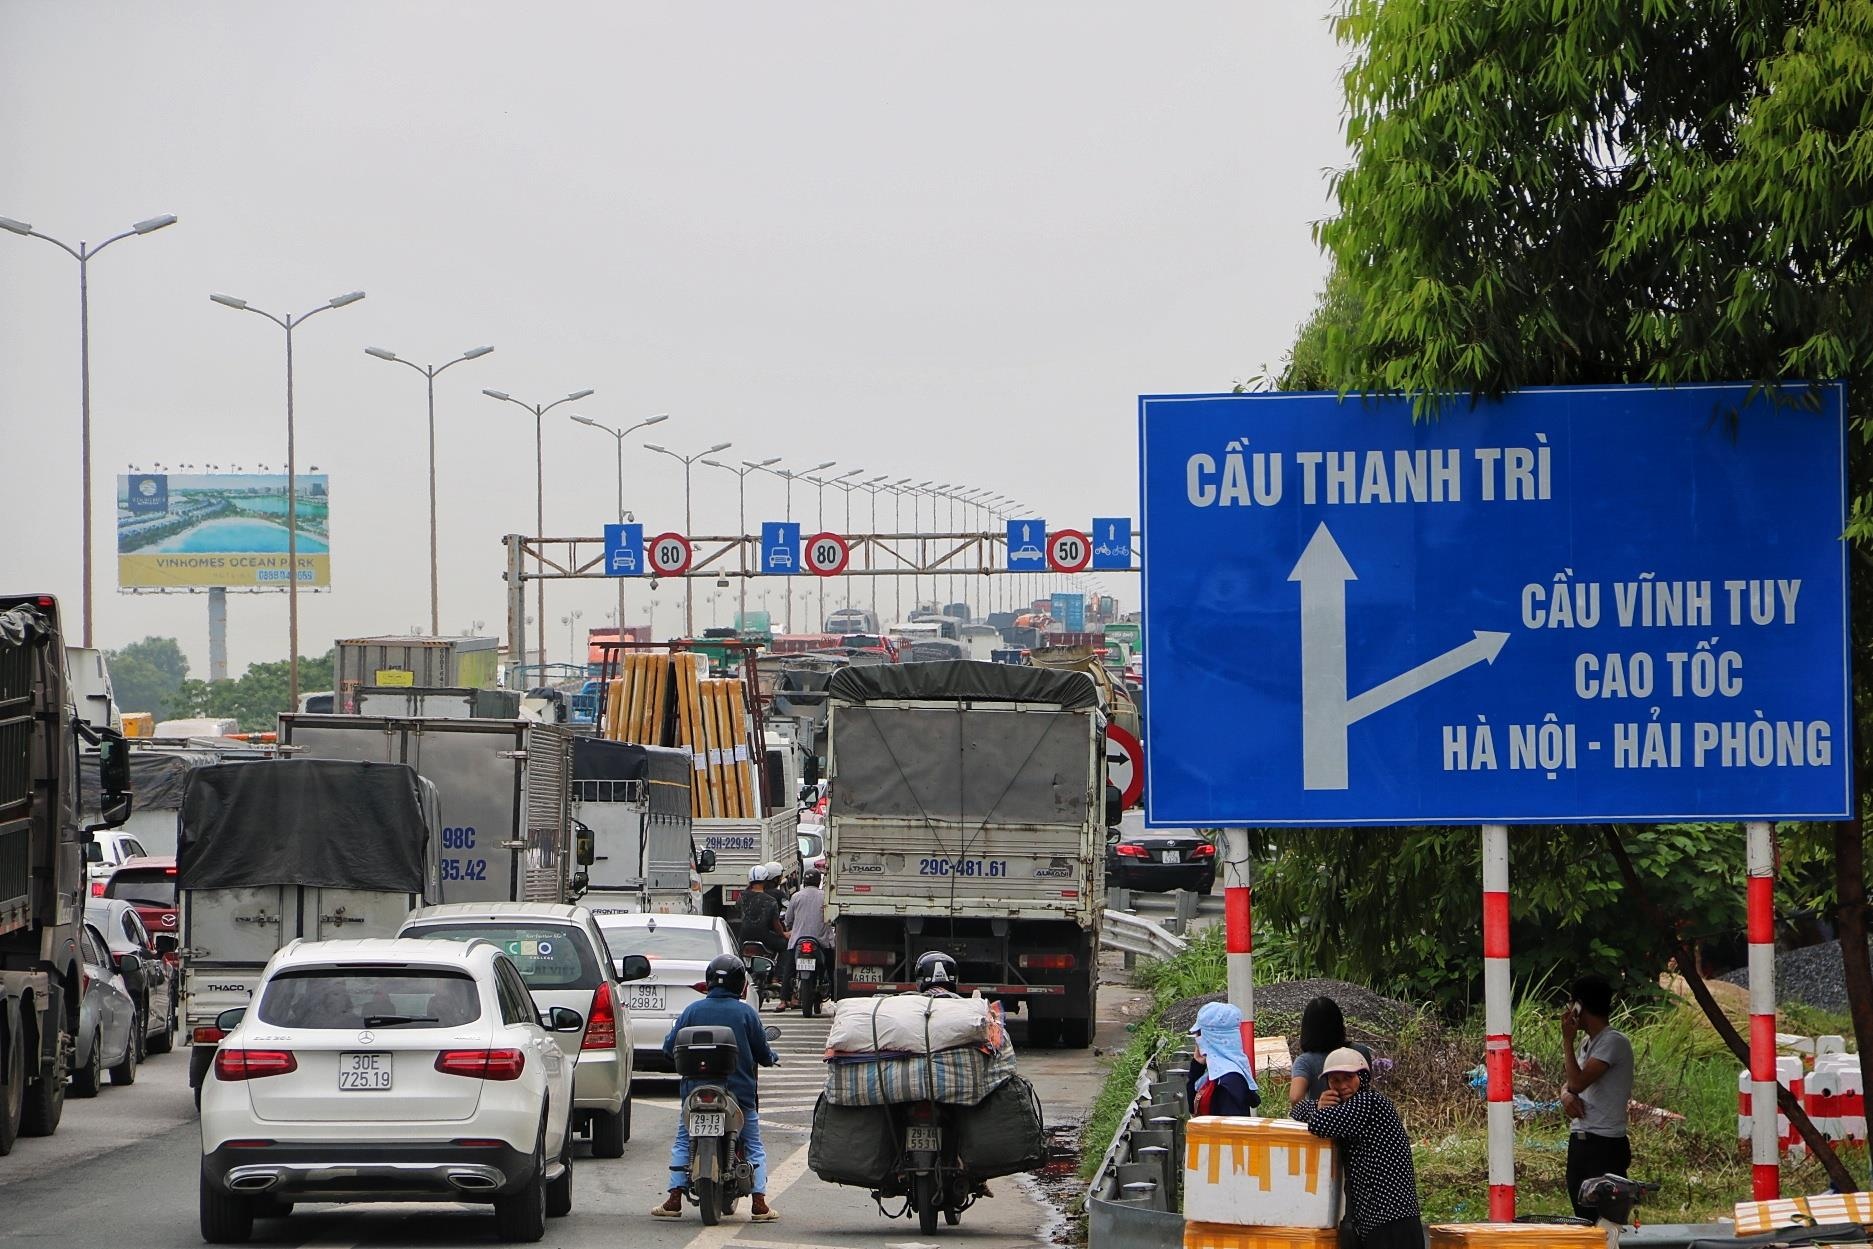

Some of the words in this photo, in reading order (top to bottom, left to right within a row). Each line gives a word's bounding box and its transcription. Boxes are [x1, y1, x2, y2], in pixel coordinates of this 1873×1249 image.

[1186, 437, 1283, 507] CẦU
[1296, 448, 1461, 505] THANH
[1474, 432, 1551, 501] TRÌ
[661, 546, 680, 564] 80
[817, 545, 836, 564] 80
[1059, 541, 1079, 561] 50
[156, 558, 225, 568] VINHOMES
[229, 557, 276, 567] OCEAN
[280, 557, 315, 567] PRK
[1521, 567, 1600, 629] CẦU
[1613, 571, 1712, 627] VĨNH
[1724, 579, 1802, 626] TUY
[1575, 651, 1654, 699] CAO
[1666, 636, 1743, 697] TỐC
[1442, 714, 1498, 770] HÀ
[1509, 713, 1576, 780] NỘI
[1614, 706, 1681, 769] HẢI
[1694, 709, 1832, 767] PHÒNG
[443, 827, 476, 849] 98C
[706, 836, 754, 850] 29H-229.62
[919, 858, 1007, 877] 29C-481.61
[207, 984, 245, 992] THACO
[638, 986, 658, 997] 99A
[631, 997, 664, 1009] 298.21
[352, 1055, 380, 1071] 30E
[341, 1071, 390, 1088] 725.19
[694, 1114, 720, 1125] 29-T3
[694, 1124, 720, 1135] 6725
